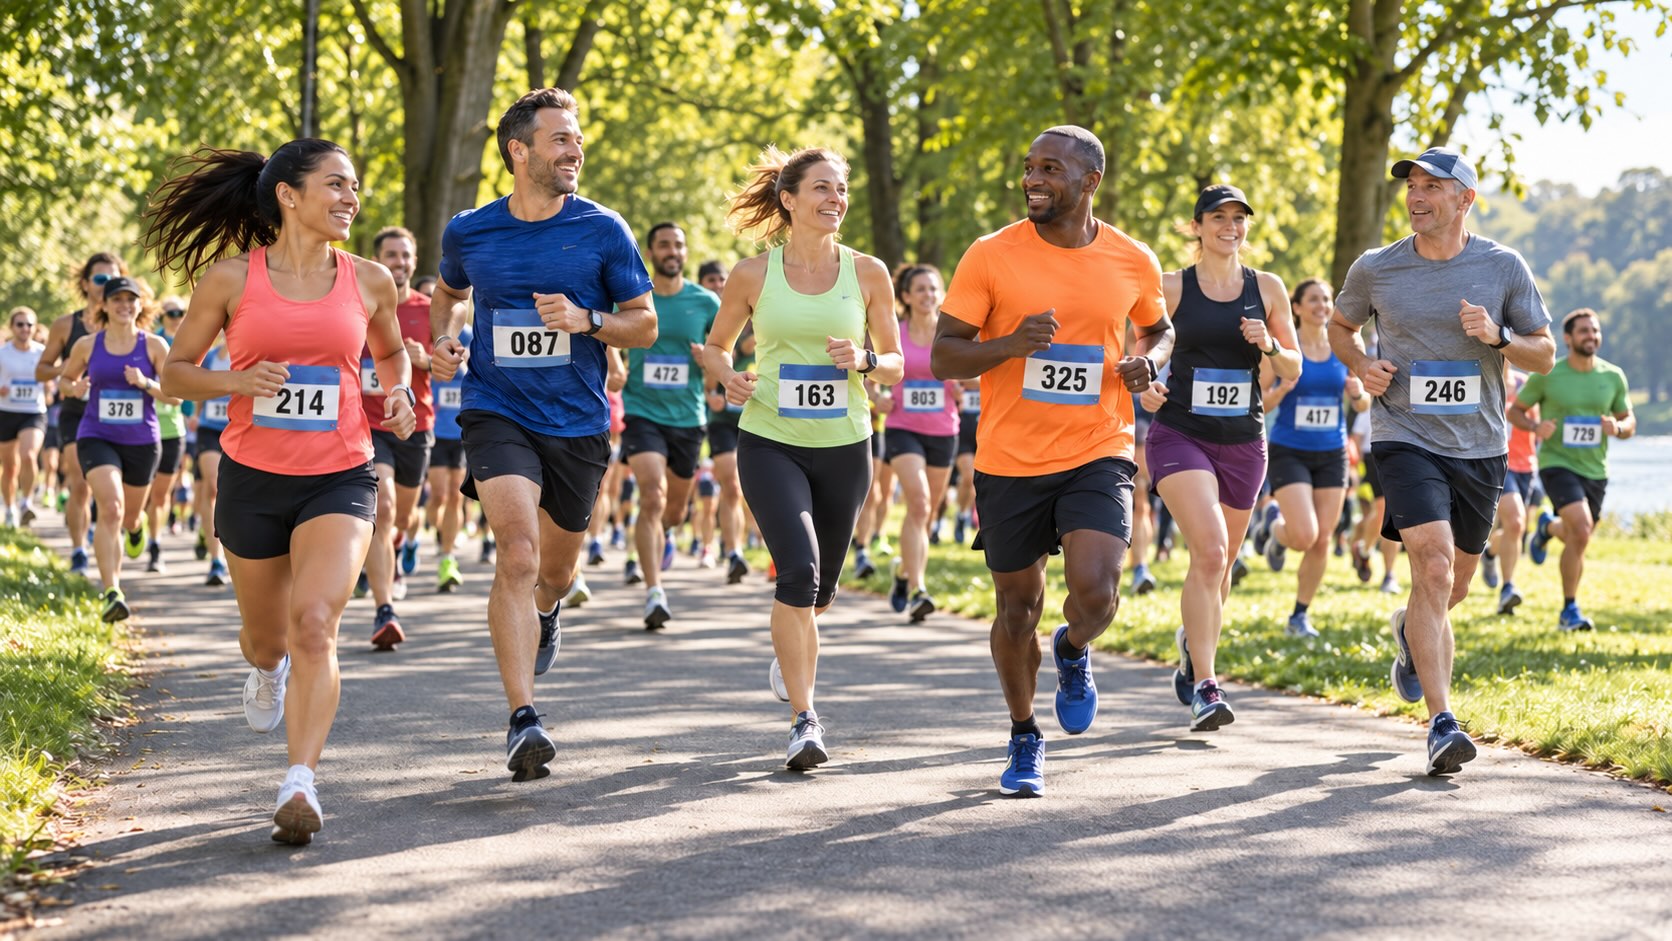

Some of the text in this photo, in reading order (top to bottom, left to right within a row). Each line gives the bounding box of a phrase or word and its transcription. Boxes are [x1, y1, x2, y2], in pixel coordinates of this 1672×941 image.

[511, 330, 559, 356] 087
[653, 367, 679, 381] 472
[1041, 364, 1087, 392] 325
[16, 387, 33, 398] 317
[795, 383, 835, 406] 163
[911, 391, 936, 406] 803
[1206, 386, 1239, 405] 192
[1425, 380, 1466, 403] 246
[108, 402, 134, 417] 378
[276, 388, 324, 416] 214
[1306, 409, 1330, 424] 417
[1572, 427, 1596, 441] 729
